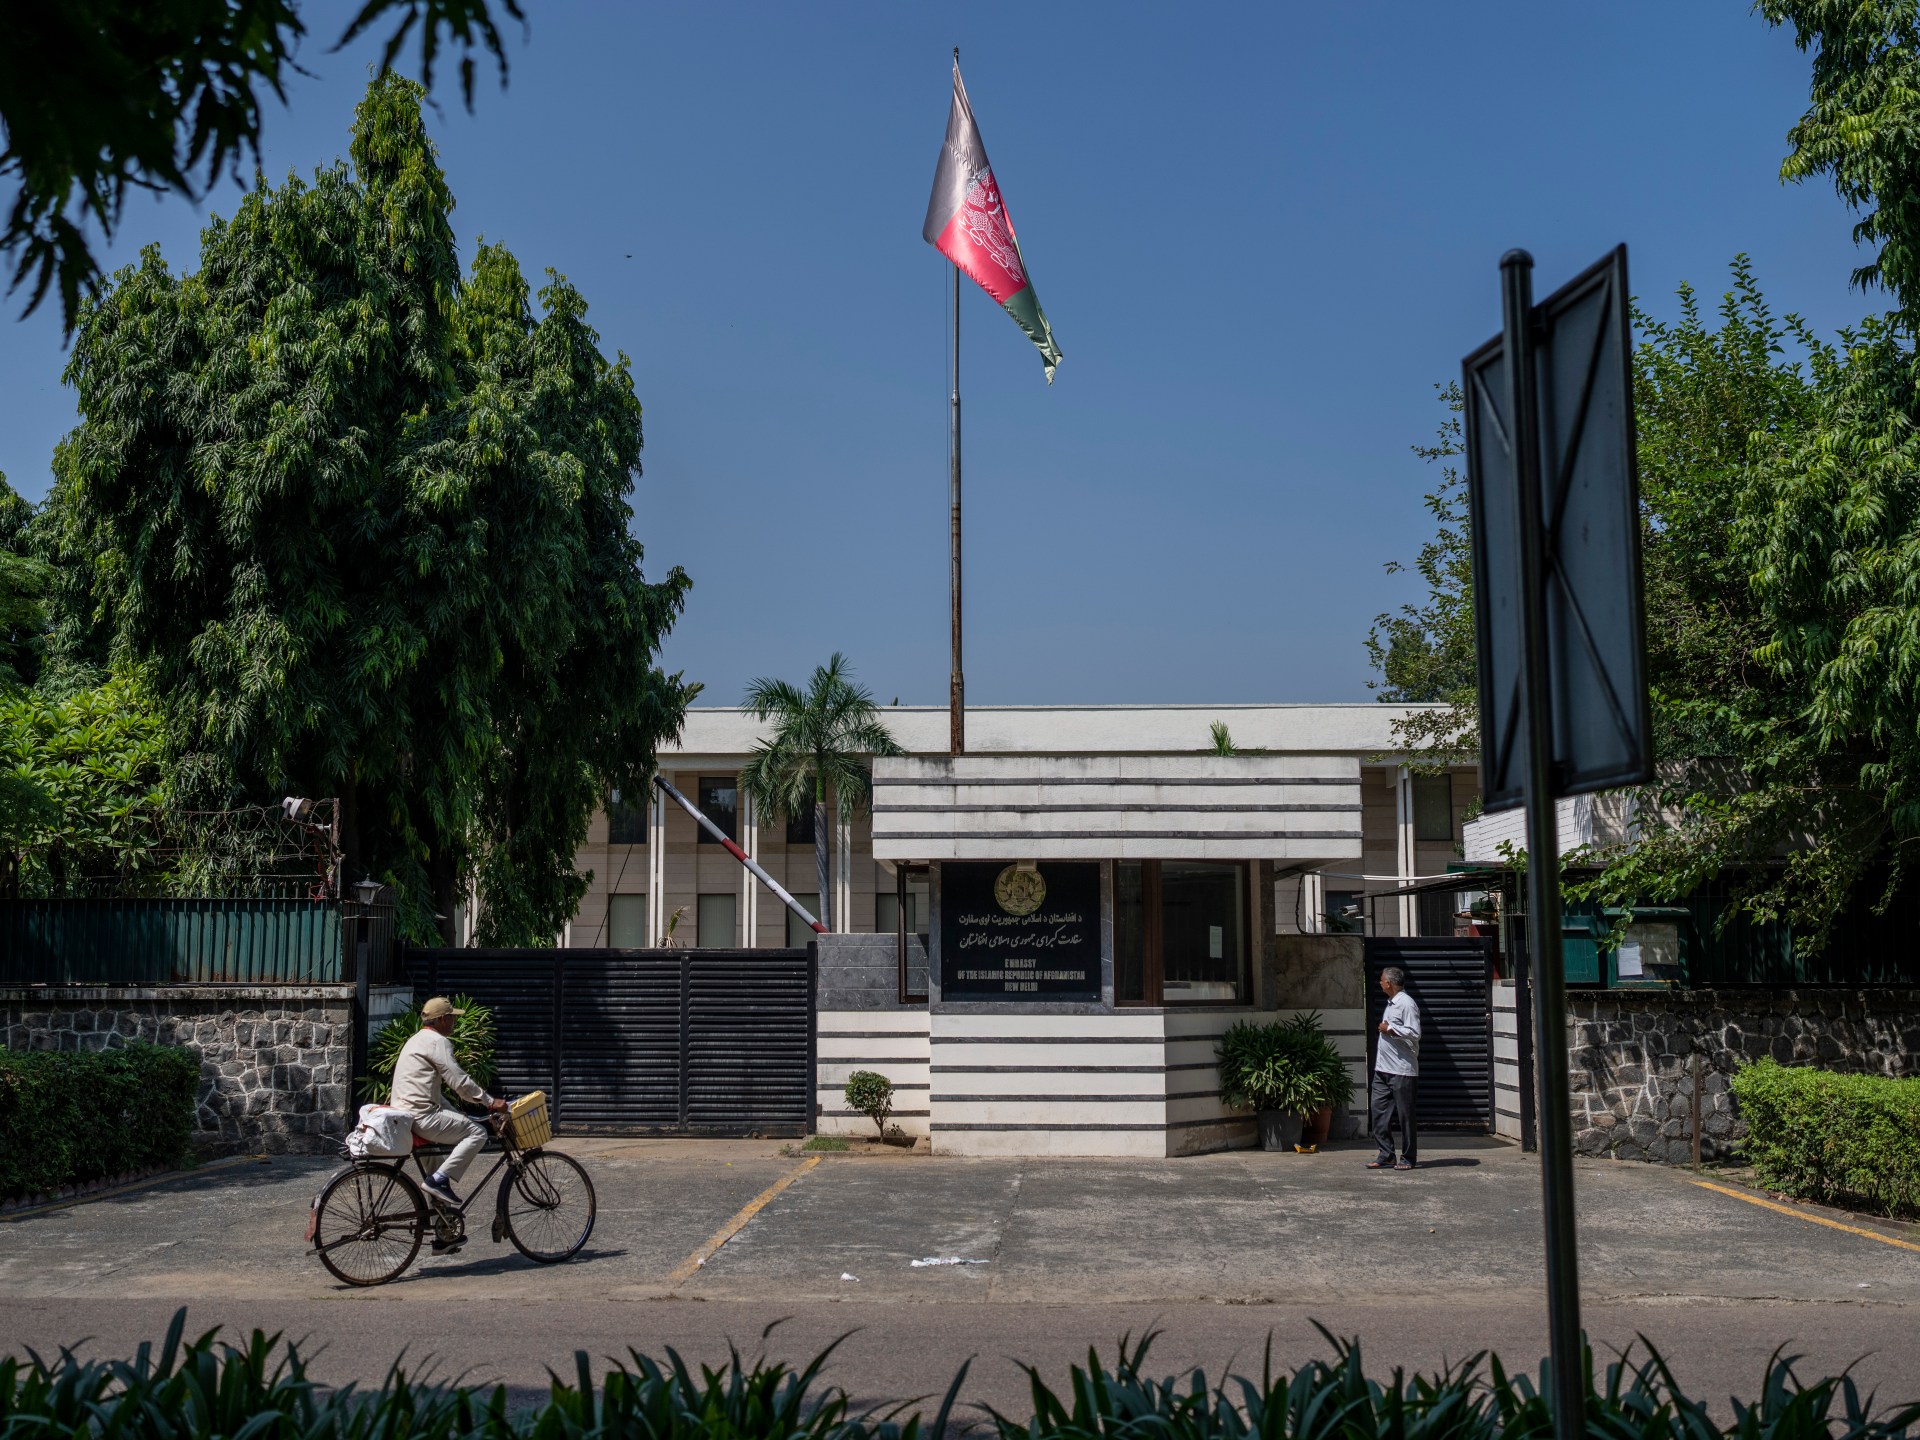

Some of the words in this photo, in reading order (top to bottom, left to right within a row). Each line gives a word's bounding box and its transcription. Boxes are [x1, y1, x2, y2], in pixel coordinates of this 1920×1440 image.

[1004, 958, 1037, 969] EMBASSY
[957, 970, 965, 980] OF
[966, 970, 978, 980] THE
[978, 970, 1004, 980] ISLAMIC
[1004, 970, 1035, 980] REPUBLIC
[1035, 970, 1043, 980] OF
[1043, 970, 1086, 980] AFGHANISTAN
[1004, 982, 1019, 992] NEW
[1020, 982, 1038, 992] DELHI
